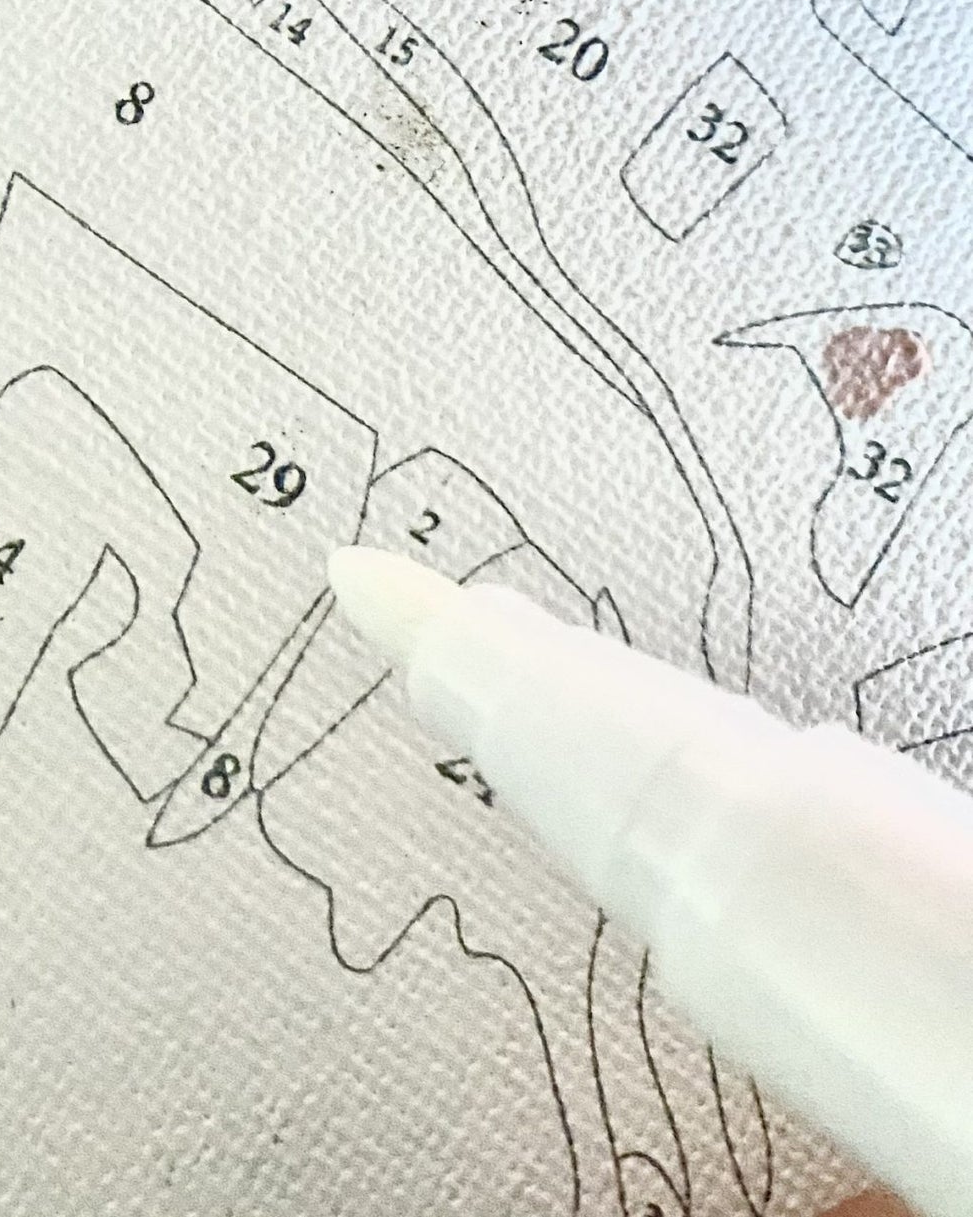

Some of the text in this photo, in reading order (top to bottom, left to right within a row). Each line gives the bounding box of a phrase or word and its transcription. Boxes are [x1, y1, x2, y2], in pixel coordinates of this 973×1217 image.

[269, 4, 312, 46] 14
[372, 22, 421, 68] 15
[537, 18, 609, 81] 20
[115, 82, 155, 125] 8
[687, 103, 749, 165] 32
[230, 441, 306, 508] 29
[843, 440, 913, 503] 32
[409, 509, 440, 545] 2
[201, 753, 241, 798] 8
